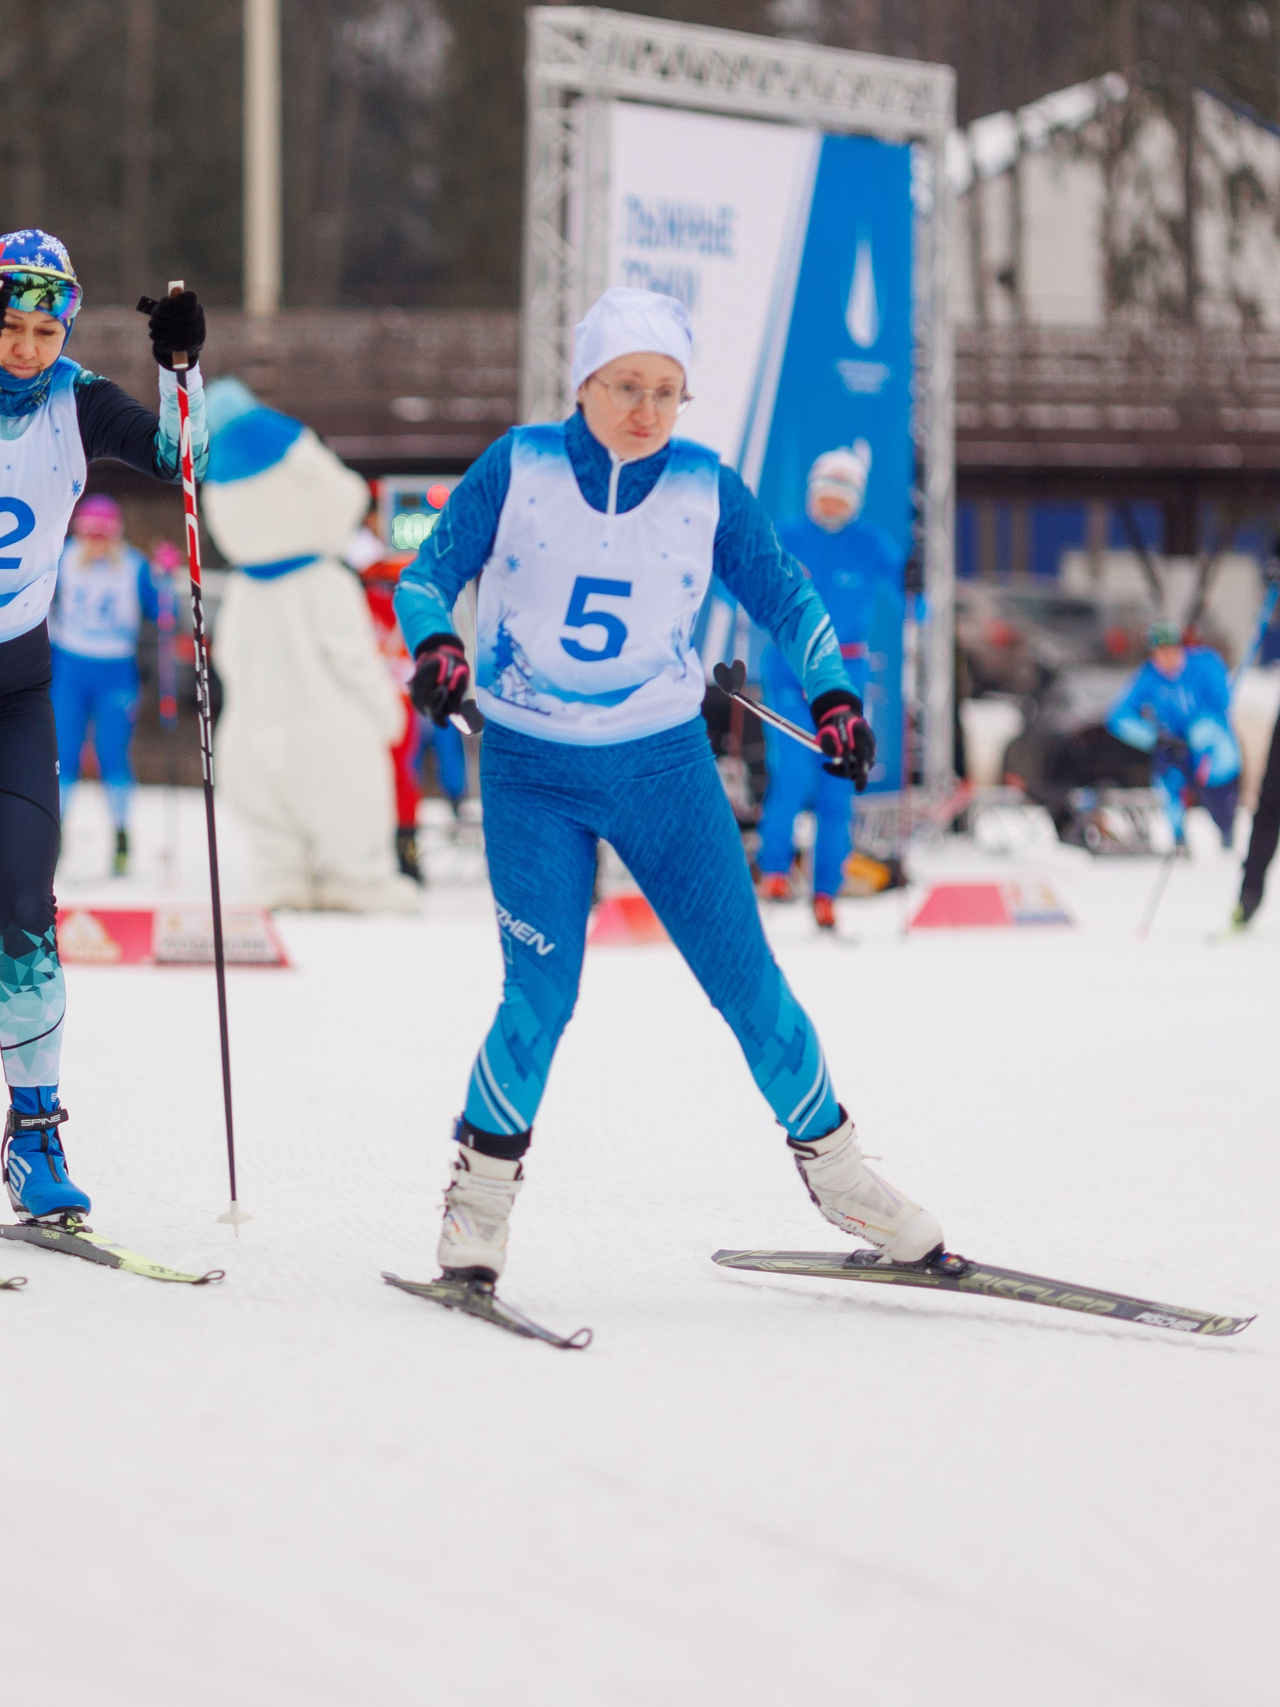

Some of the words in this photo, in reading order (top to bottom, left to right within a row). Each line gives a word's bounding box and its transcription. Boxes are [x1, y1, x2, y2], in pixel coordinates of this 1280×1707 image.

[559, 576, 633, 662] 5
[20, 1114, 61, 1127] SPINE
[1134, 1312, 1200, 1332] FISCHER
